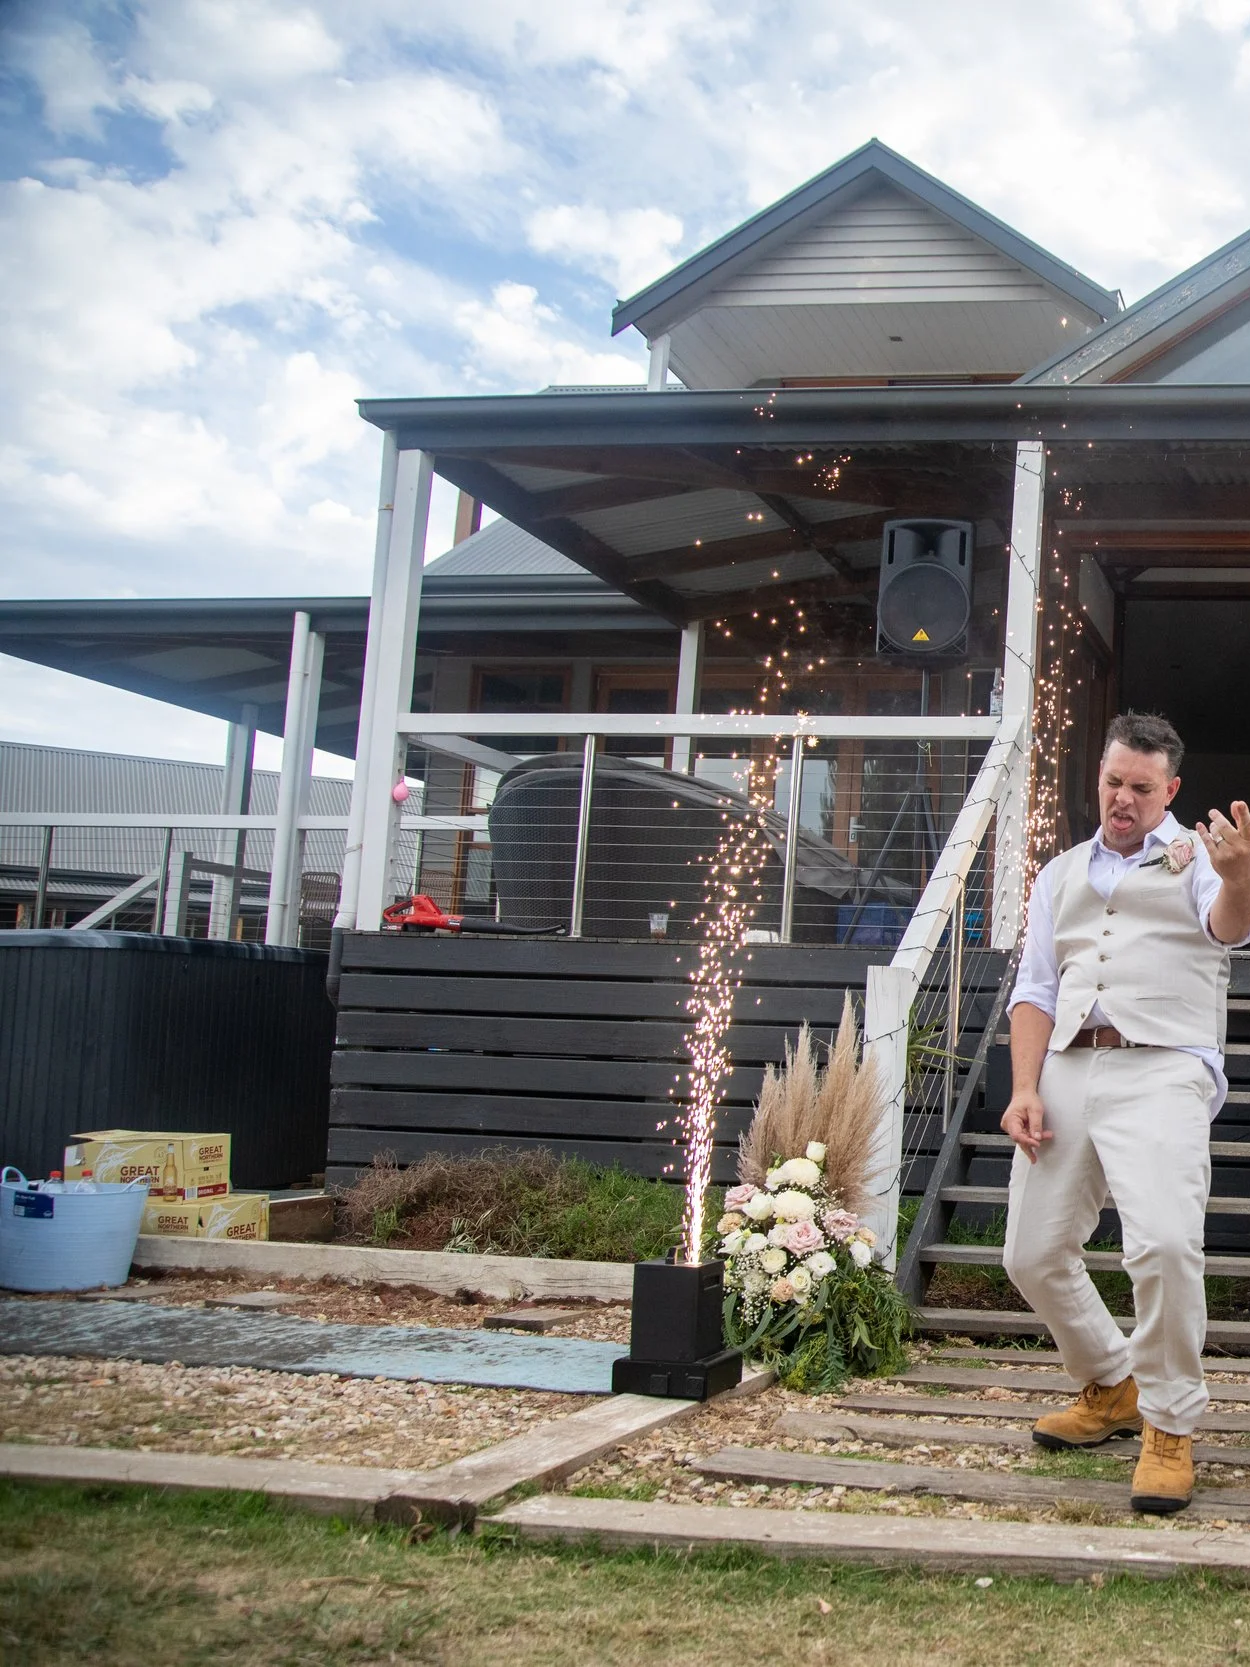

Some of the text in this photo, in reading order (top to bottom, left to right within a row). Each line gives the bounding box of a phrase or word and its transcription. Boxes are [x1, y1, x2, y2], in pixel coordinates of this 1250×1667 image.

[199, 1145, 223, 1155] GREAT
[199, 1153, 223, 1161] NORTHERN
[120, 1166, 160, 1176] GREAT
[120, 1176, 160, 1184] NORHERN
[158, 1216, 188, 1224] GREAT
[227, 1222, 256, 1236] GREAT
